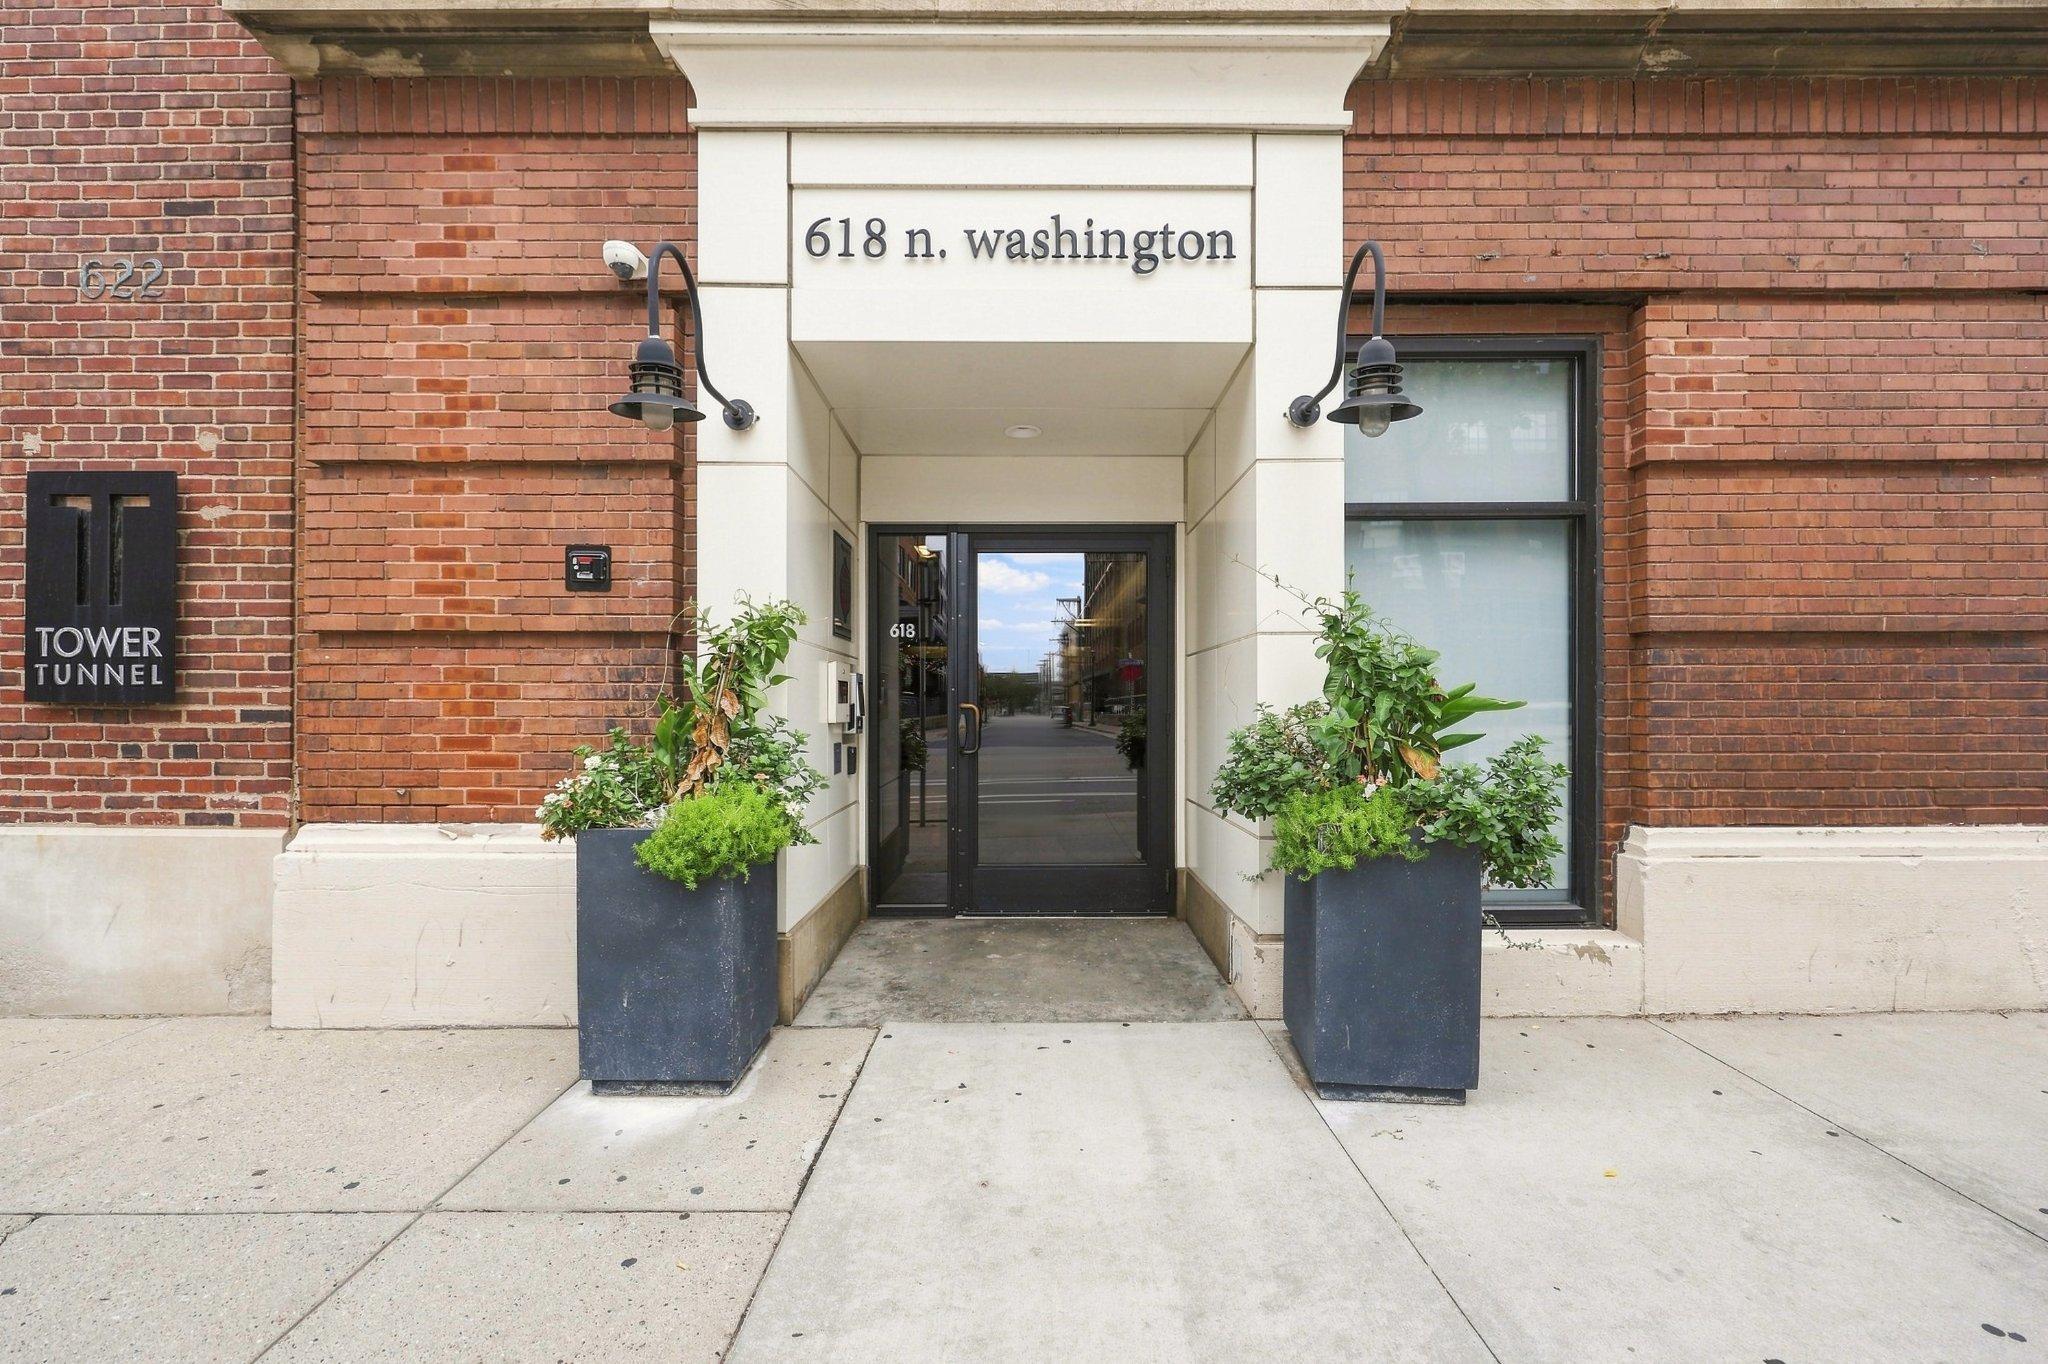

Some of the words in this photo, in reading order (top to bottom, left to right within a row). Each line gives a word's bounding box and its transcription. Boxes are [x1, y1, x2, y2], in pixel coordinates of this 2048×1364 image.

[804, 217, 888, 258] 618
[905, 228, 947, 258] n.
[964, 214, 1237, 275] washington
[81, 258, 165, 299] 622
[35, 626, 162, 658] TOWER
[889, 623, 916, 638] 618
[34, 663, 163, 686] TUNNEL
